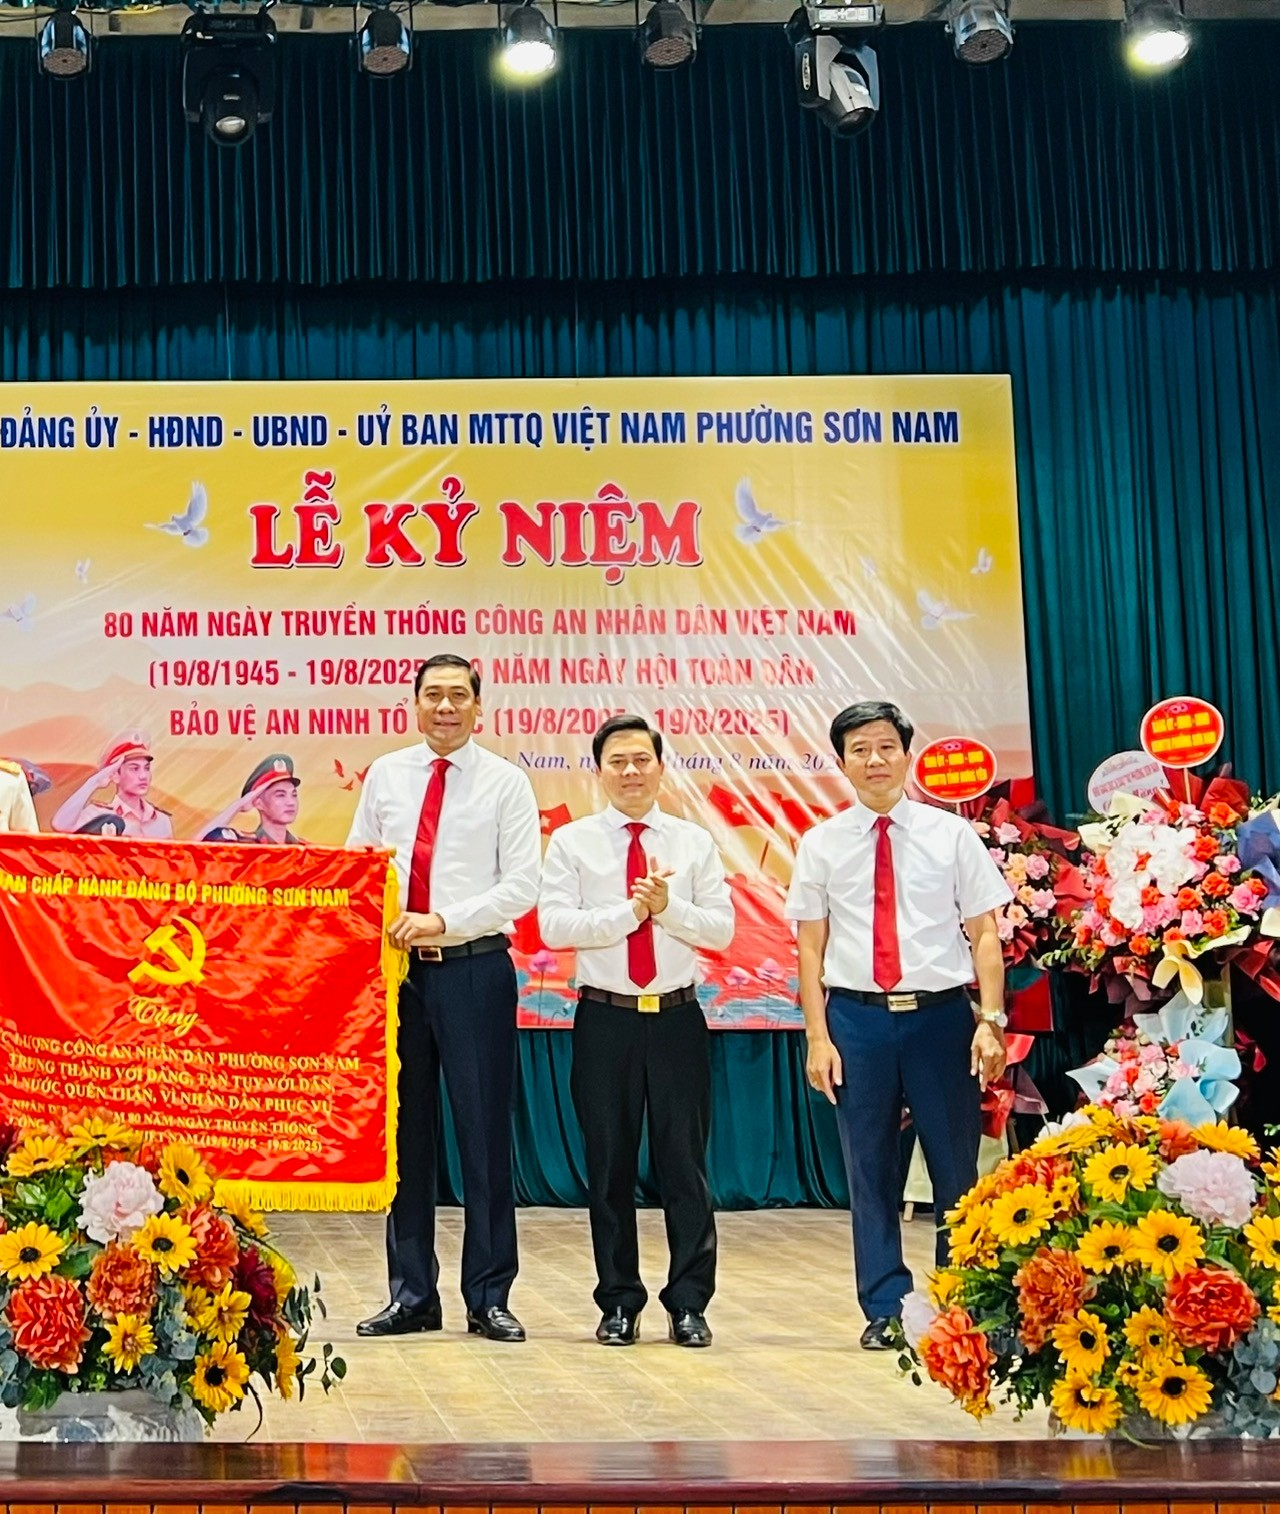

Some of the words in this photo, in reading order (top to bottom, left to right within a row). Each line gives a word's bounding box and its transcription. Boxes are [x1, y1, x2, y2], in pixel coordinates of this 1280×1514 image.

[0, 406, 75, 448] ĐẢNG
[85, 406, 119, 448] ỦY
[148, 416, 222, 448] HĐND
[253, 415, 327, 447] UBND
[357, 404, 391, 447] UỶ
[402, 414, 459, 446] BAN
[469, 412, 543, 448] MTTQ
[552, 406, 609, 452] VIỆT
[621, 412, 686, 445] NAM
[696, 404, 812, 444] PHƯỜNG
[823, 410, 881, 444] SƠN
[892, 411, 959, 443] NAM
[249, 470, 345, 569] LỄ
[362, 475, 480, 569] KỶ
[500, 480, 704, 586] NIỆM
[103, 612, 132, 638] 80
[142, 605, 199, 637] NĂM
[207, 604, 273, 637] NGÀY
[281, 601, 375, 637] TRUYỀN
[384, 600, 466, 636] THỐNG
[476, 604, 543, 636] CÔNG
[552, 609, 587, 636] AN
[596, 604, 666, 636] NHÂN
[675, 603, 727, 636] DÂN
[735, 603, 789, 641] VIỆT
[797, 609, 857, 637] NAM
[149, 660, 279, 689] (19/8/1945
[493, 652, 551, 684] NĂM
[561, 652, 625, 684] NGÀY
[636, 653, 677, 691] HỘI
[686, 652, 753, 685] TOÀN
[762, 652, 815, 685] DÂN
[170, 701, 218, 736] BẢO
[228, 704, 257, 741] VỆ
[265, 709, 300, 735] AN
[308, 708, 369, 735] NINH
[378, 697, 408, 735] TỔ
[517, 751, 571, 771] Nam,
[31, 870, 74, 896] CHẤP
[78, 874, 123, 897] HÀNH
[126, 875, 171, 901] ĐẢNG
[175, 879, 198, 906] BỘ
[201, 882, 268, 906] PHƯỜNG
[272, 886, 307, 907] SƠN
[311, 887, 350, 907] NAM
[128, 994, 199, 1037] Tặng
[9, 1052, 55, 1074] TRUNG
[60, 1060, 111, 1080] THÀNH
[267, 1073, 295, 1091] VỚI
[63, 1038, 108, 1056] CÔNG
[110, 1045, 131, 1058] AN
[323, 1056, 360, 1071] NAM
[181, 1089, 224, 1108] NHÂN
[144, 1111, 174, 1127] NĂM
[177, 1115, 212, 1129] NGÀY
